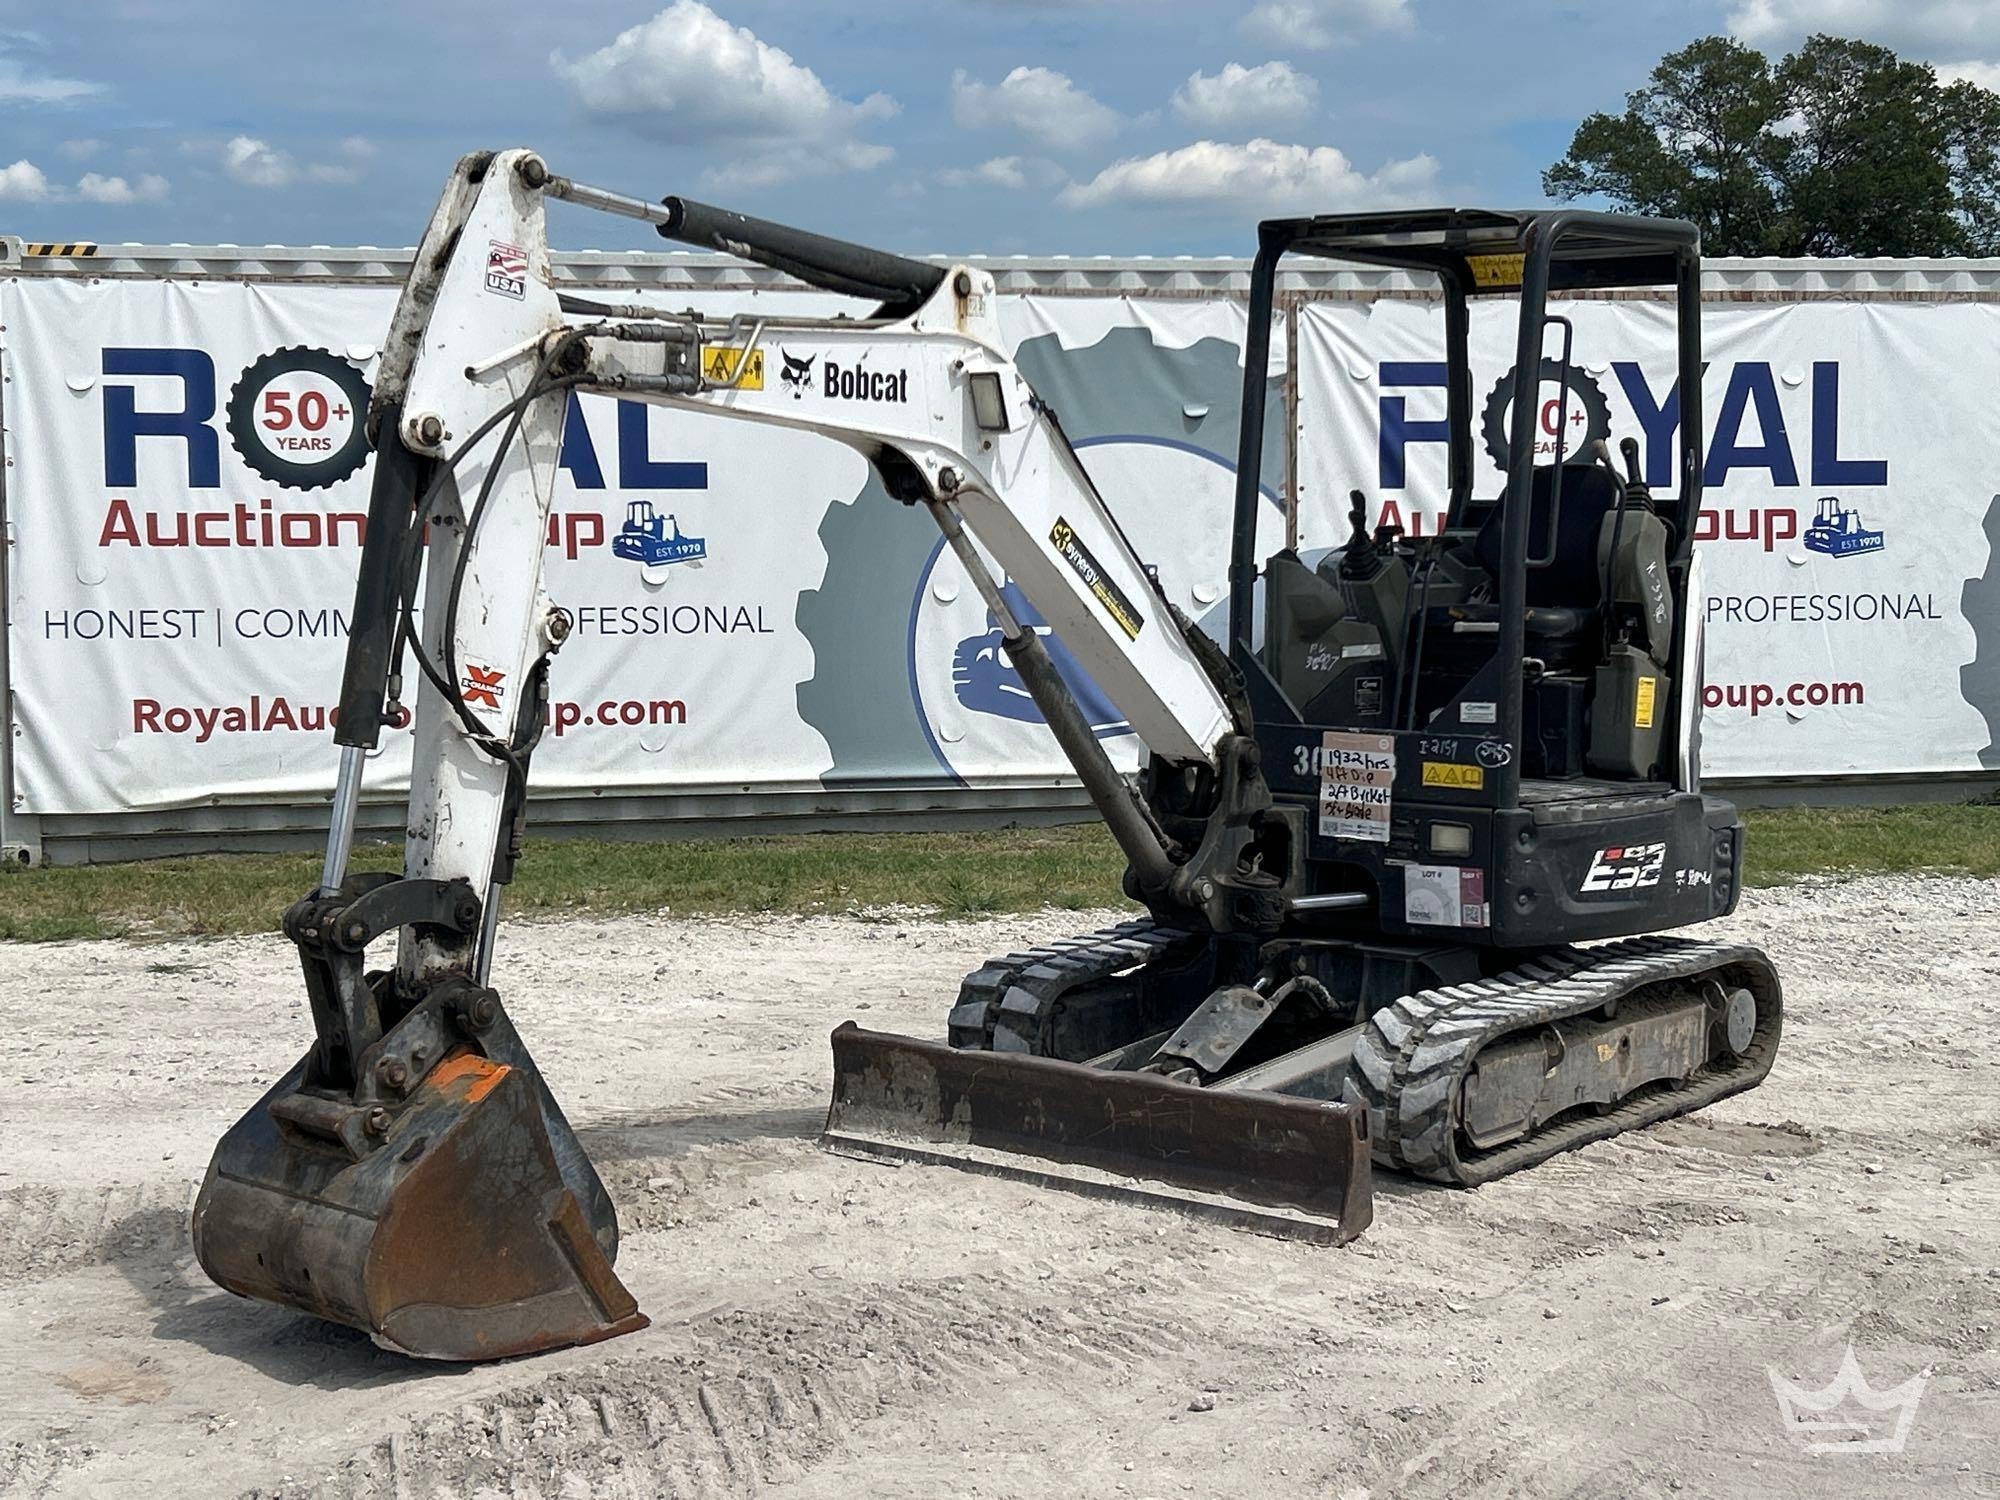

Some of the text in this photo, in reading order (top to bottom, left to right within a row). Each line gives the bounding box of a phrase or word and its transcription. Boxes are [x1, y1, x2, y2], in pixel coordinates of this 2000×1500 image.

[488, 275, 522, 294] USA
[824, 361, 907, 404] Bobcat
[262, 391, 350, 431] 50+
[1541, 399, 1585, 436] 0+
[276, 437, 332, 451] YEARS
[98, 498, 368, 547] Auction
[676, 543, 701, 555] 1970
[1859, 536, 1881, 547] 1970
[1707, 593, 1942, 622] PROFESSIONAL
[45, 608, 205, 639] HONEST
